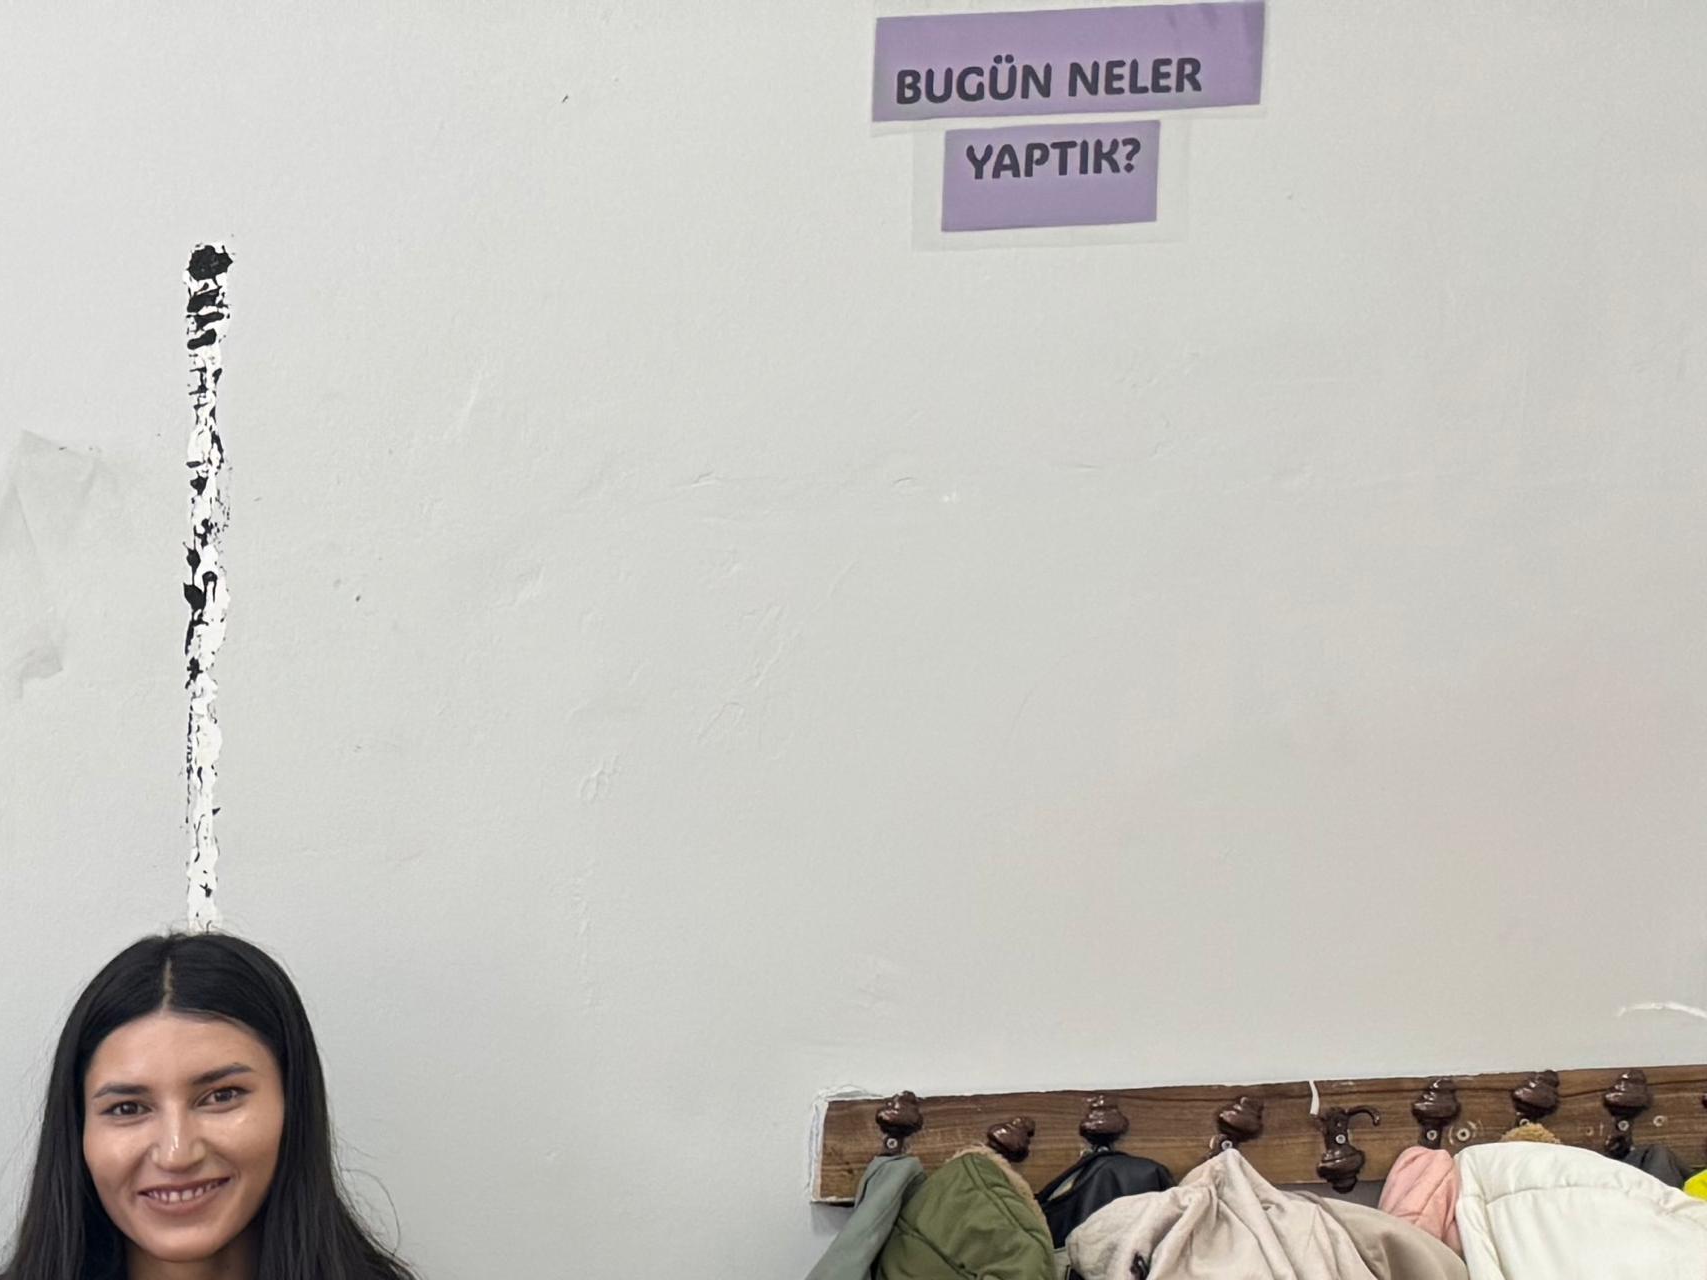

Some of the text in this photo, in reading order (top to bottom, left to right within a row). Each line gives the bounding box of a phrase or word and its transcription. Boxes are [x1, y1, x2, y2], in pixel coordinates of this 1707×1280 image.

[895, 54, 1203, 105] BUGÜN NELER
[965, 137, 1142, 180] YAPTIK?
